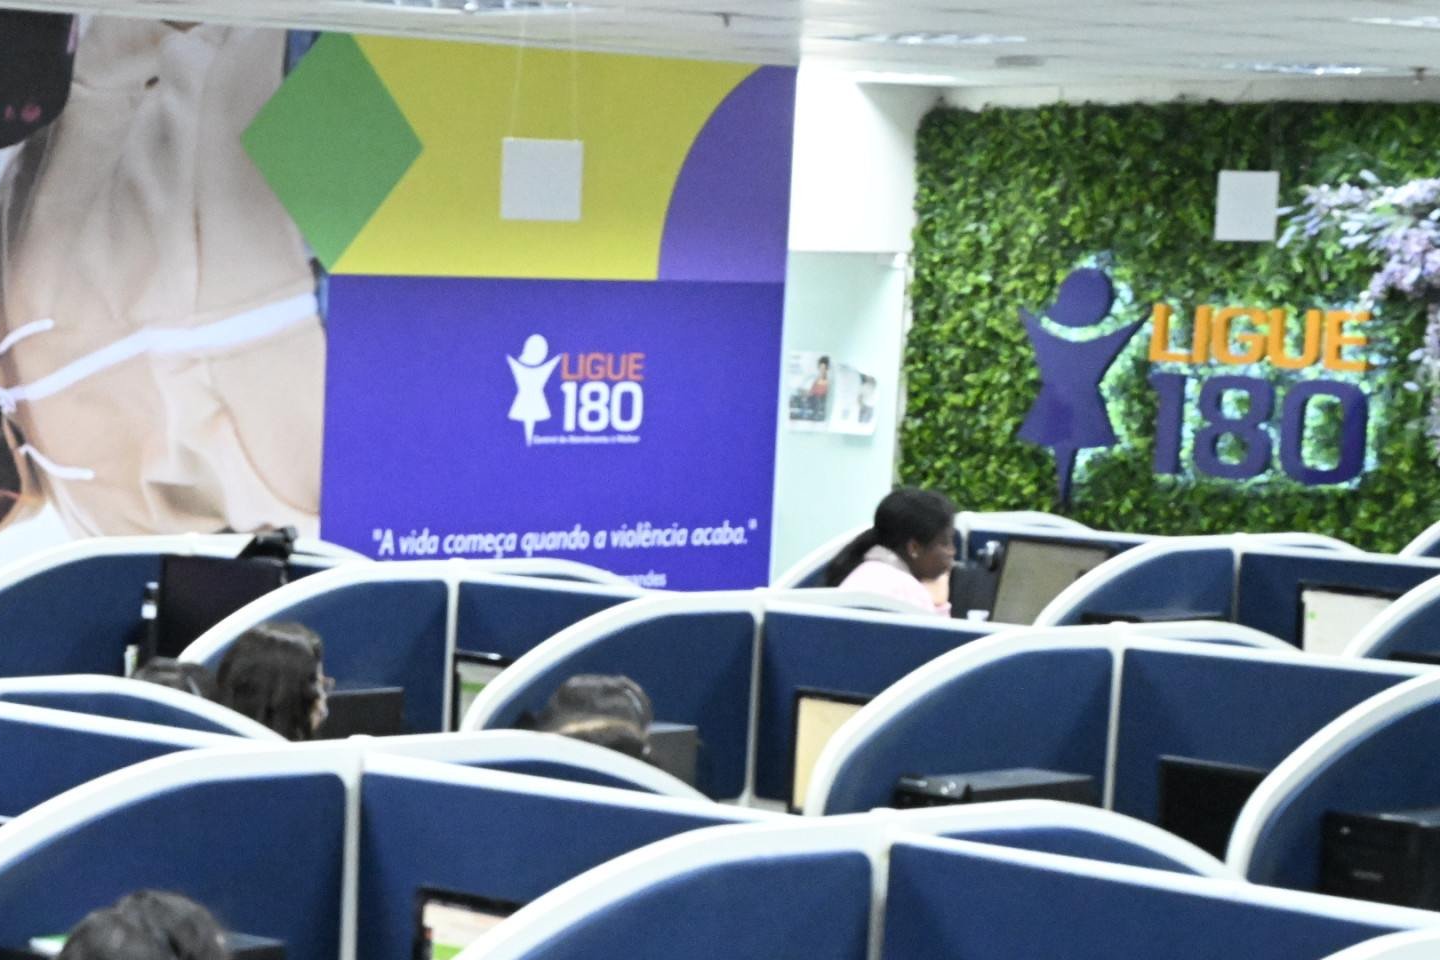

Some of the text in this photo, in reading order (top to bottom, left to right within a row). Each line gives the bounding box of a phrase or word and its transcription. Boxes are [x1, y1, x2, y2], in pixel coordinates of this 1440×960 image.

[1149, 303, 1372, 372] LIGUE
[561, 352, 645, 381] LIGUE
[561, 381, 644, 432] 180
[1148, 373, 1369, 485] 180
[399, 527, 439, 555] vida
[442, 532, 518, 558] começa
[520, 523, 590, 557] quando
[593, 529, 607, 549] a
[610, 521, 688, 548] violência
